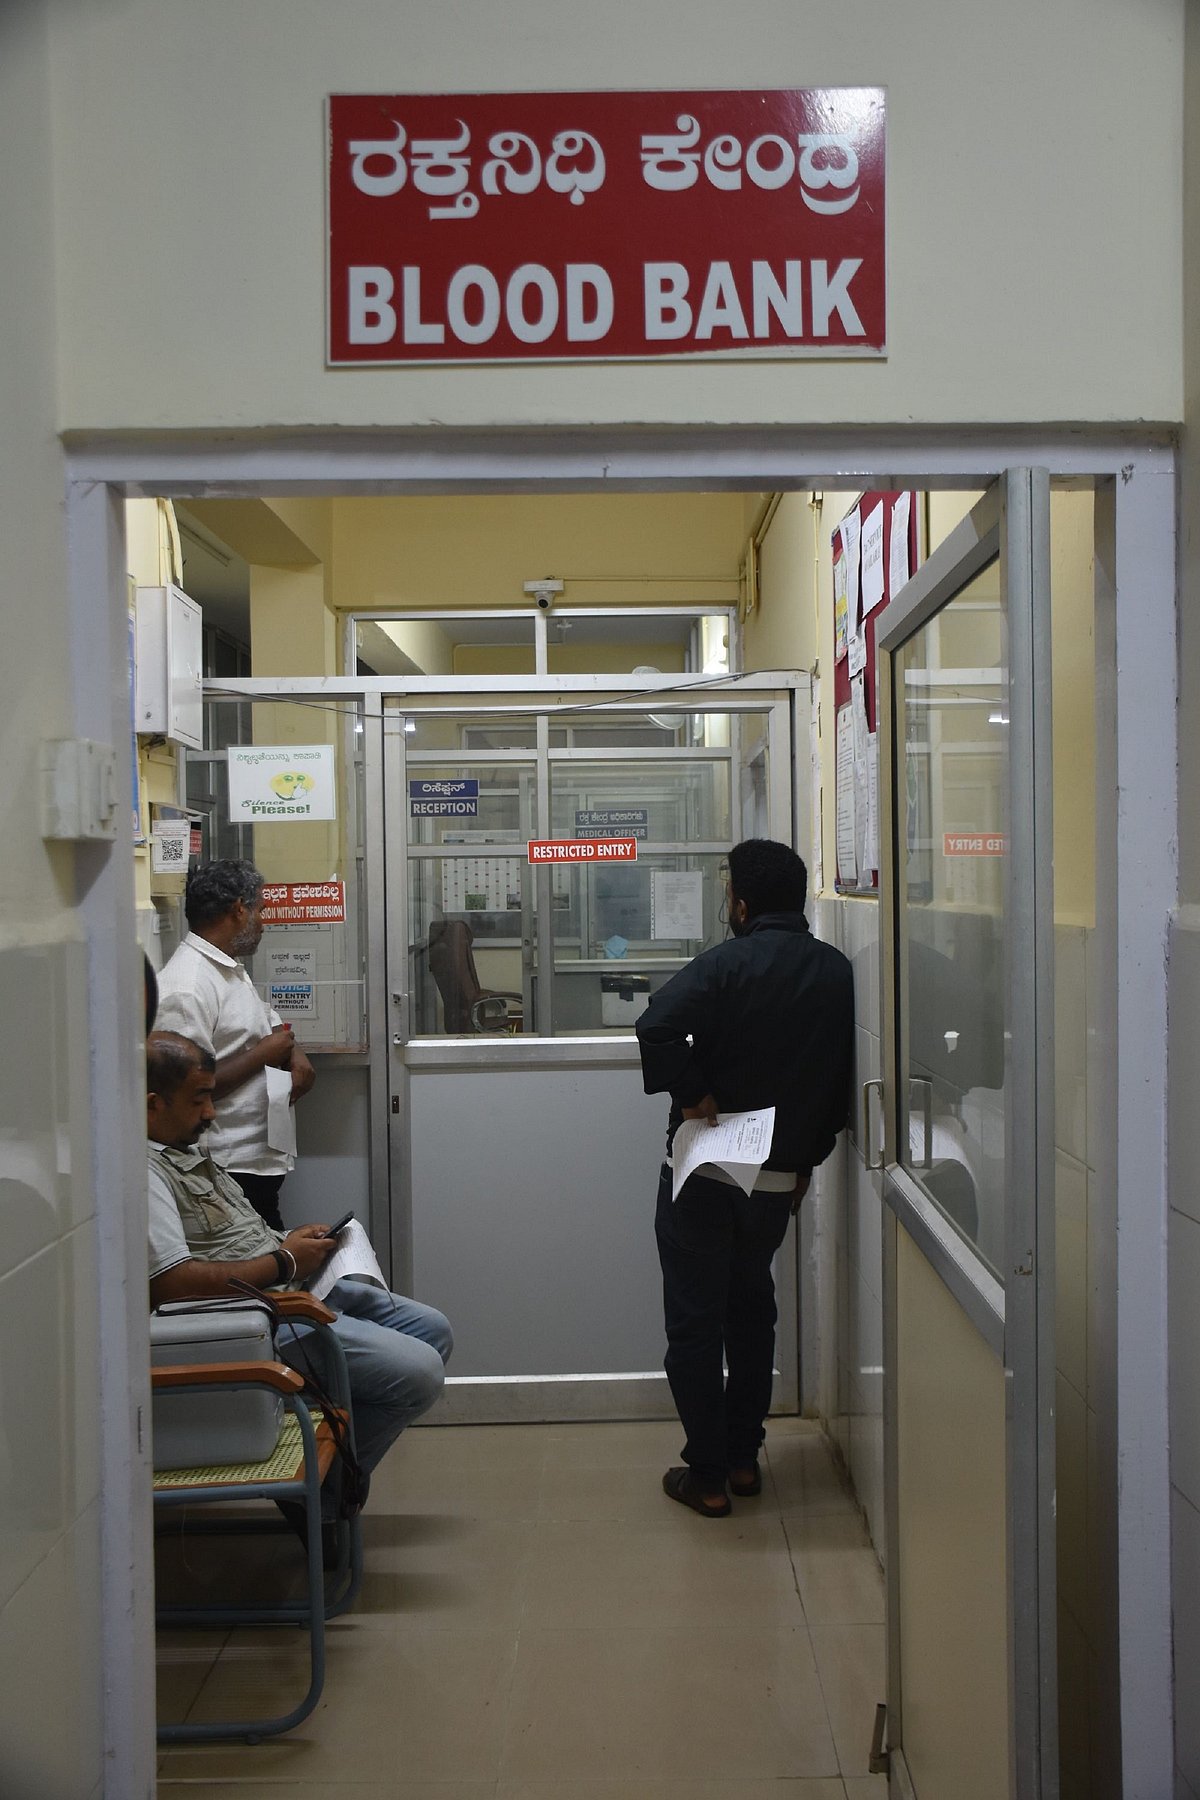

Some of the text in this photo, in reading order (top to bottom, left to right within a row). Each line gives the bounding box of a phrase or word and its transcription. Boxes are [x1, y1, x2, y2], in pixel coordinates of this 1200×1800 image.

[348, 114, 861, 220] ರಕ್ತನಿಧಿ ಕೇಂದ್ರ
[348, 258, 867, 344] BLOOD BANK
[241, 799, 285, 808] Silence
[252, 804, 311, 815] Please!
[413, 802, 476, 814] RECEPTION
[577, 828, 645, 838] MEDICAL OFFICER
[533, 843, 632, 859] RESTRICTED ENTRY
[277, 906, 304, 918] WITHOUT
[306, 905, 343, 918] PERMISSION
